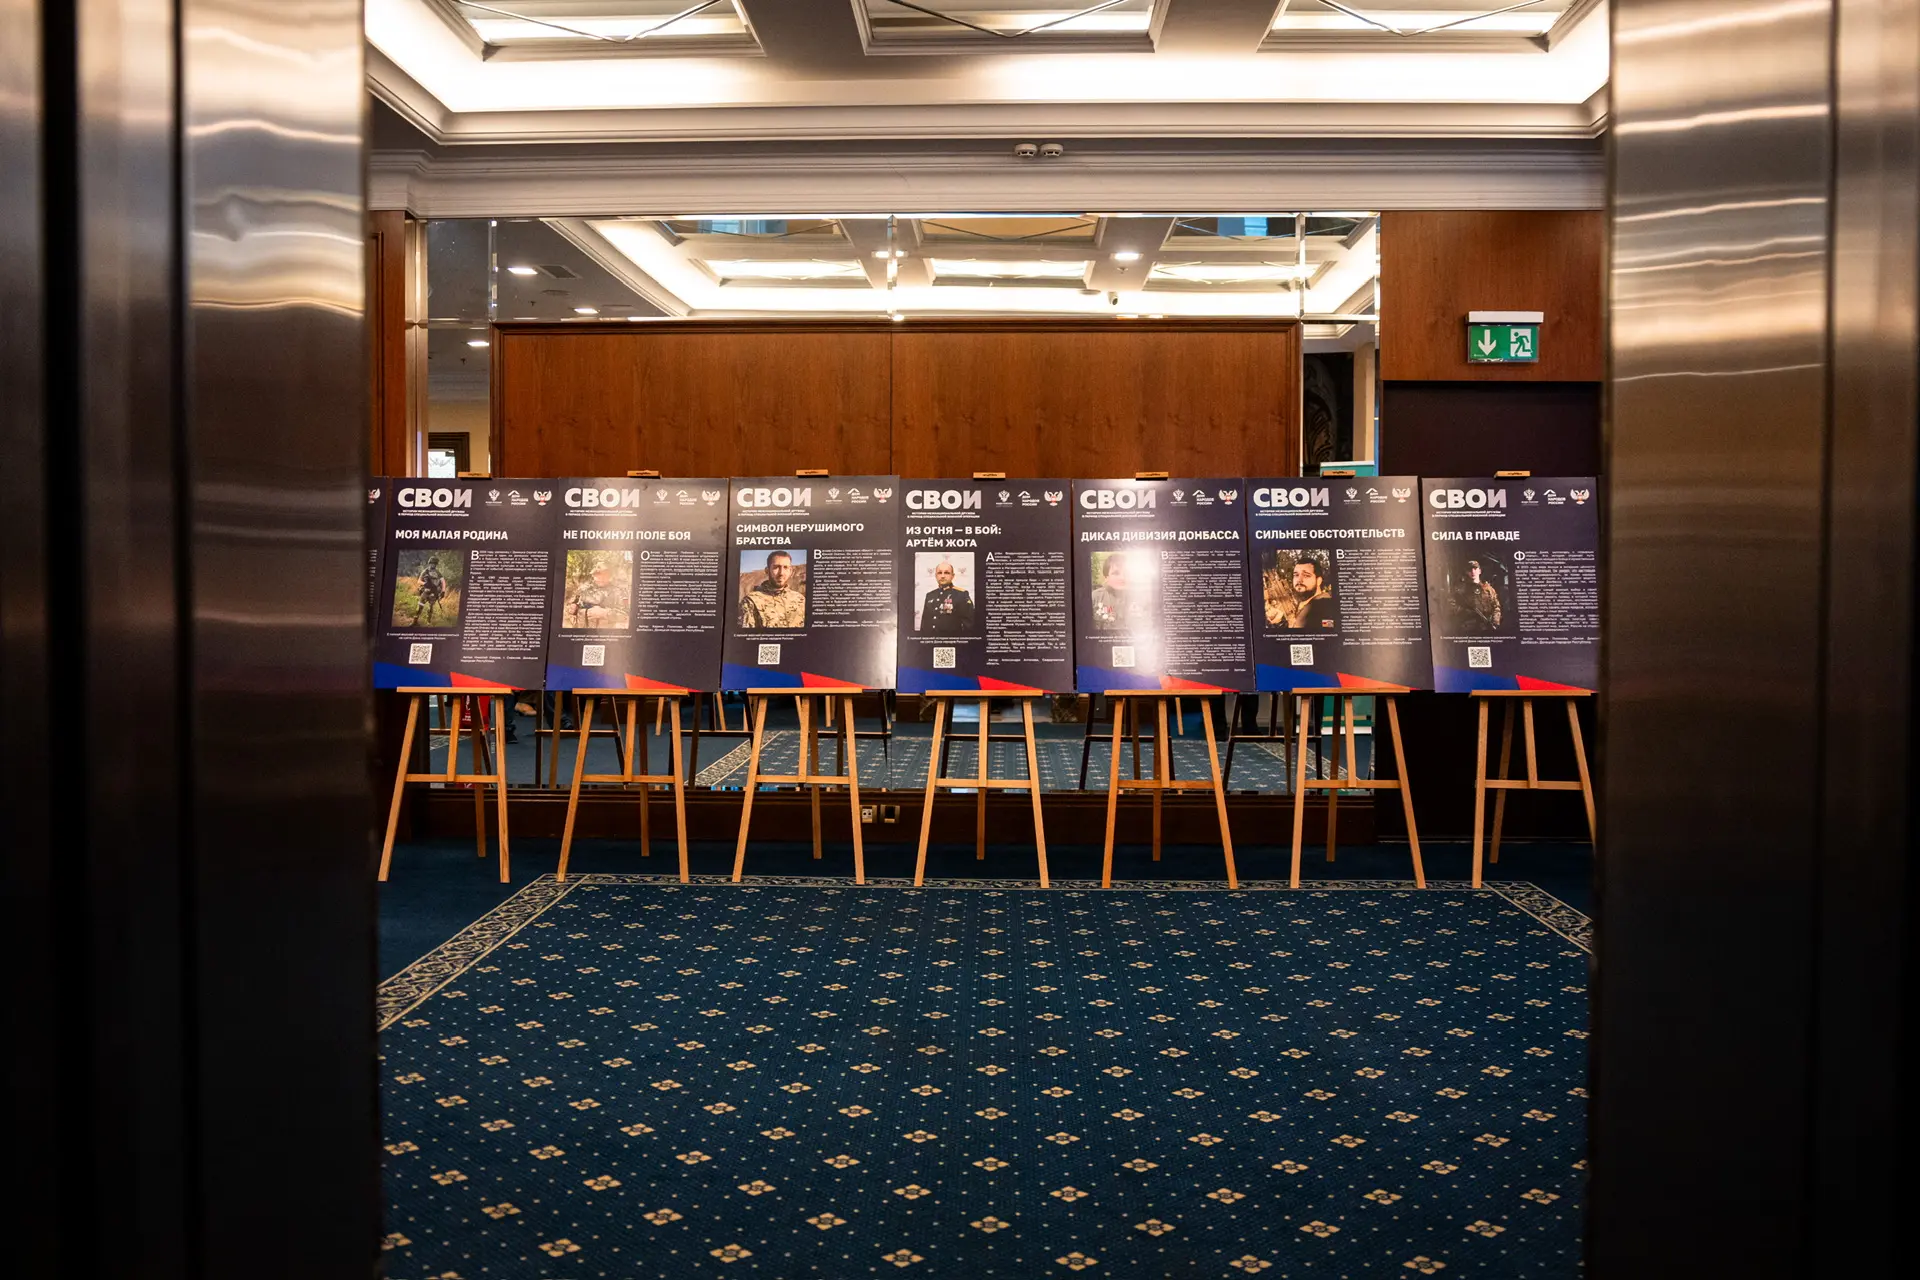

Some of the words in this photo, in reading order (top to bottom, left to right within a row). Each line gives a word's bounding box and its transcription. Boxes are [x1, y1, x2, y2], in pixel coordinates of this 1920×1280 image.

[398, 488, 472, 507] СВОИ
[564, 488, 640, 508] СВОИ
[737, 488, 811, 507] СВОИ
[906, 490, 981, 509] СВОИ
[1080, 490, 1156, 509] СВОИ
[1254, 488, 1329, 507] СВОИ
[1429, 489, 1506, 508] СВОИ
[737, 524, 783, 532] СИМВОЛ
[976, 525, 1002, 534] БОЙ:
[396, 530, 419, 539] МОЯ
[422, 531, 460, 539] МАЛАЯ
[463, 531, 508, 540] РОДИНА
[564, 530, 577, 539] НЕ
[580, 530, 634, 540] ПОКИНУЛ
[636, 531, 666, 540] ПОЛЕ
[669, 531, 690, 540] БОЯ
[1081, 532, 1120, 542] ДИКАЯ
[1122, 532, 1174, 540] ДИВИЗИЯ
[1178, 531, 1239, 541] ДОНБАССА
[1256, 530, 1307, 539] СИЛЬНЕЕ
[1310, 529, 1405, 539] ОБСТОЯТЕЛЬСТВ
[1432, 531, 1463, 540] СИЛА
[1466, 532, 1473, 540] В
[1476, 531, 1520, 541] ПРАВДЕ
[737, 537, 791, 545] БРАТСТВА
[906, 538, 944, 548] АРТЁМ
[946, 539, 977, 547] ЖОГА
